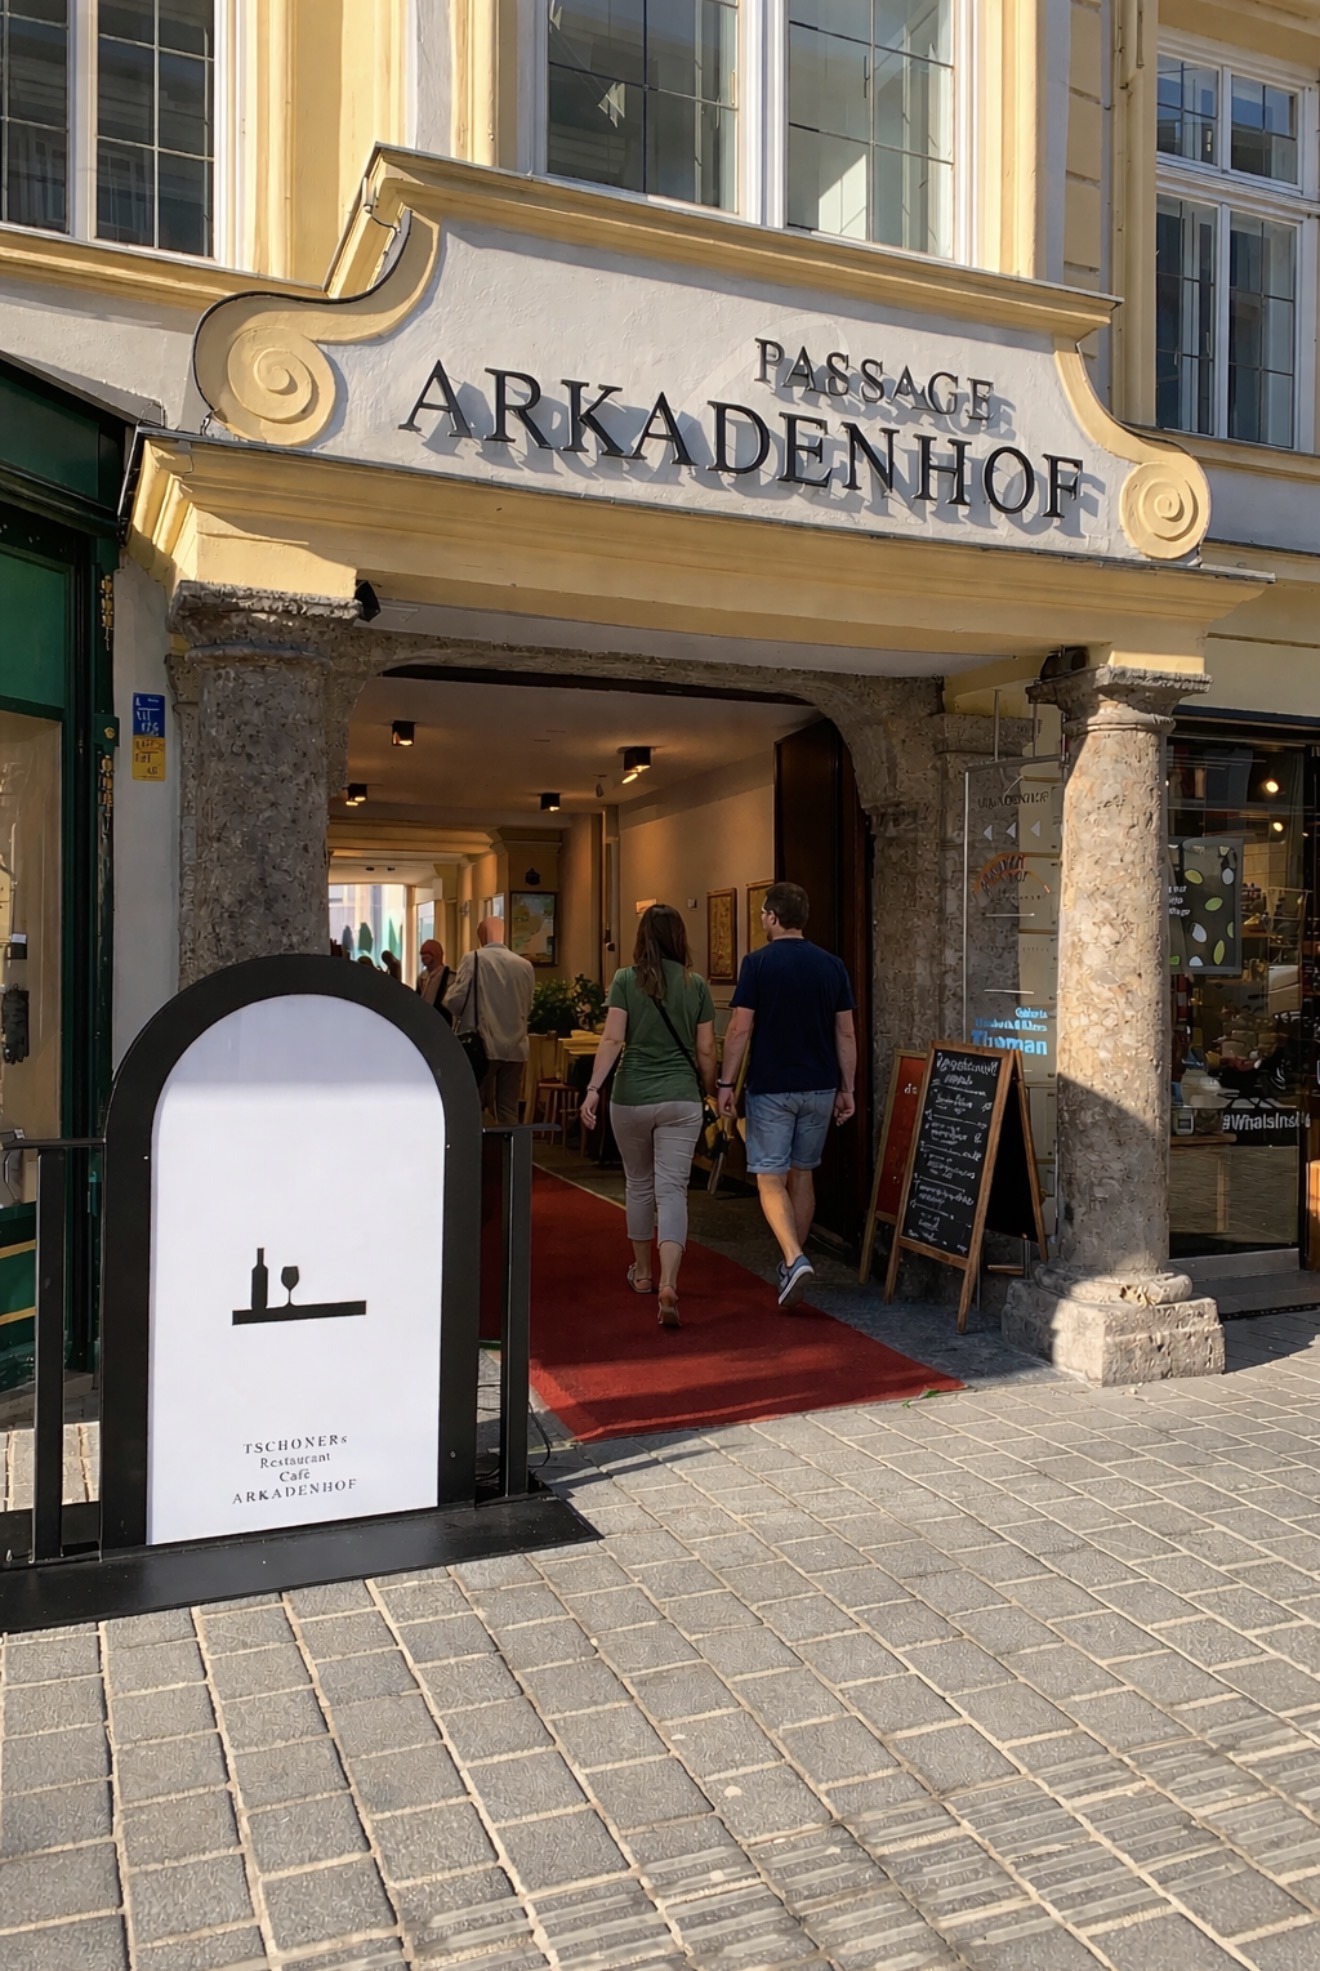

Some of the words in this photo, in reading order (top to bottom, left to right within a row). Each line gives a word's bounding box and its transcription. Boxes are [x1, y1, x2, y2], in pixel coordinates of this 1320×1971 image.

[754, 337, 994, 421] PASSAGE
[398, 359, 1084, 519] ARKADENHOF
[971, 1029, 1047, 1056] Thoman
[260, 1452, 331, 1469] Restaurant
[232, 1478, 357, 1505] ARKADENHOF
